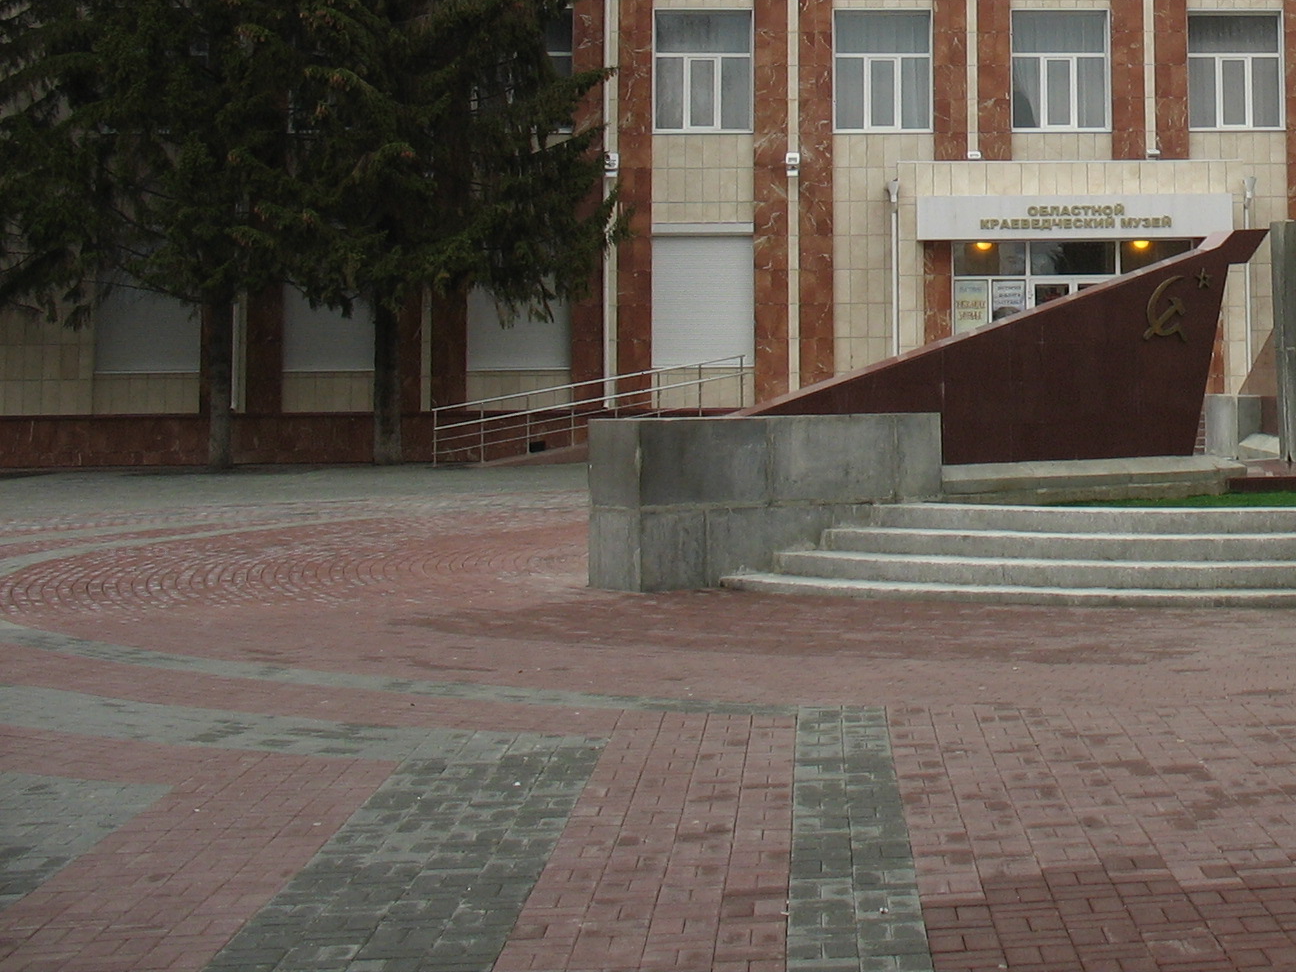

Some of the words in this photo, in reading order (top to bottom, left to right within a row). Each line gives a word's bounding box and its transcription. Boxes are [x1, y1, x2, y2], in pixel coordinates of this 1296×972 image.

[1027, 203, 1125, 216] ОБЛАСТНОЙ
[980, 216, 1116, 230] КРАЕВЕДЧЕСКИЙ
[1120, 215, 1172, 229] МУЗЕЙ
